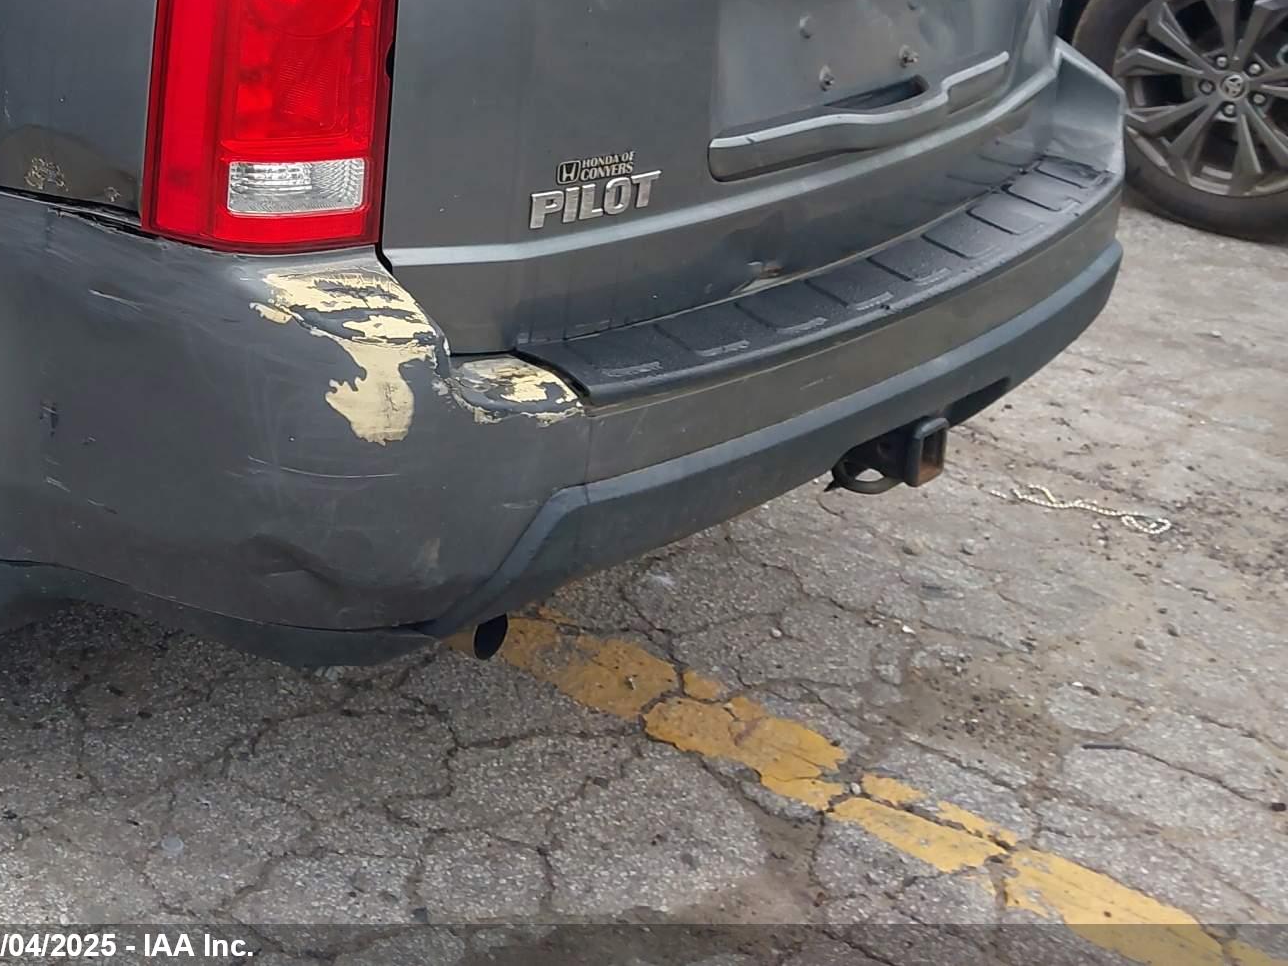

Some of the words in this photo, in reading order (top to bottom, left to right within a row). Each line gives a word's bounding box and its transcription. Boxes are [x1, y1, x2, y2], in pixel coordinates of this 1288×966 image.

[581, 153, 620, 168] HONDA
[621, 150, 636, 162] OF
[580, 161, 634, 181] CONYERS
[529, 169, 663, 230] PILOT
